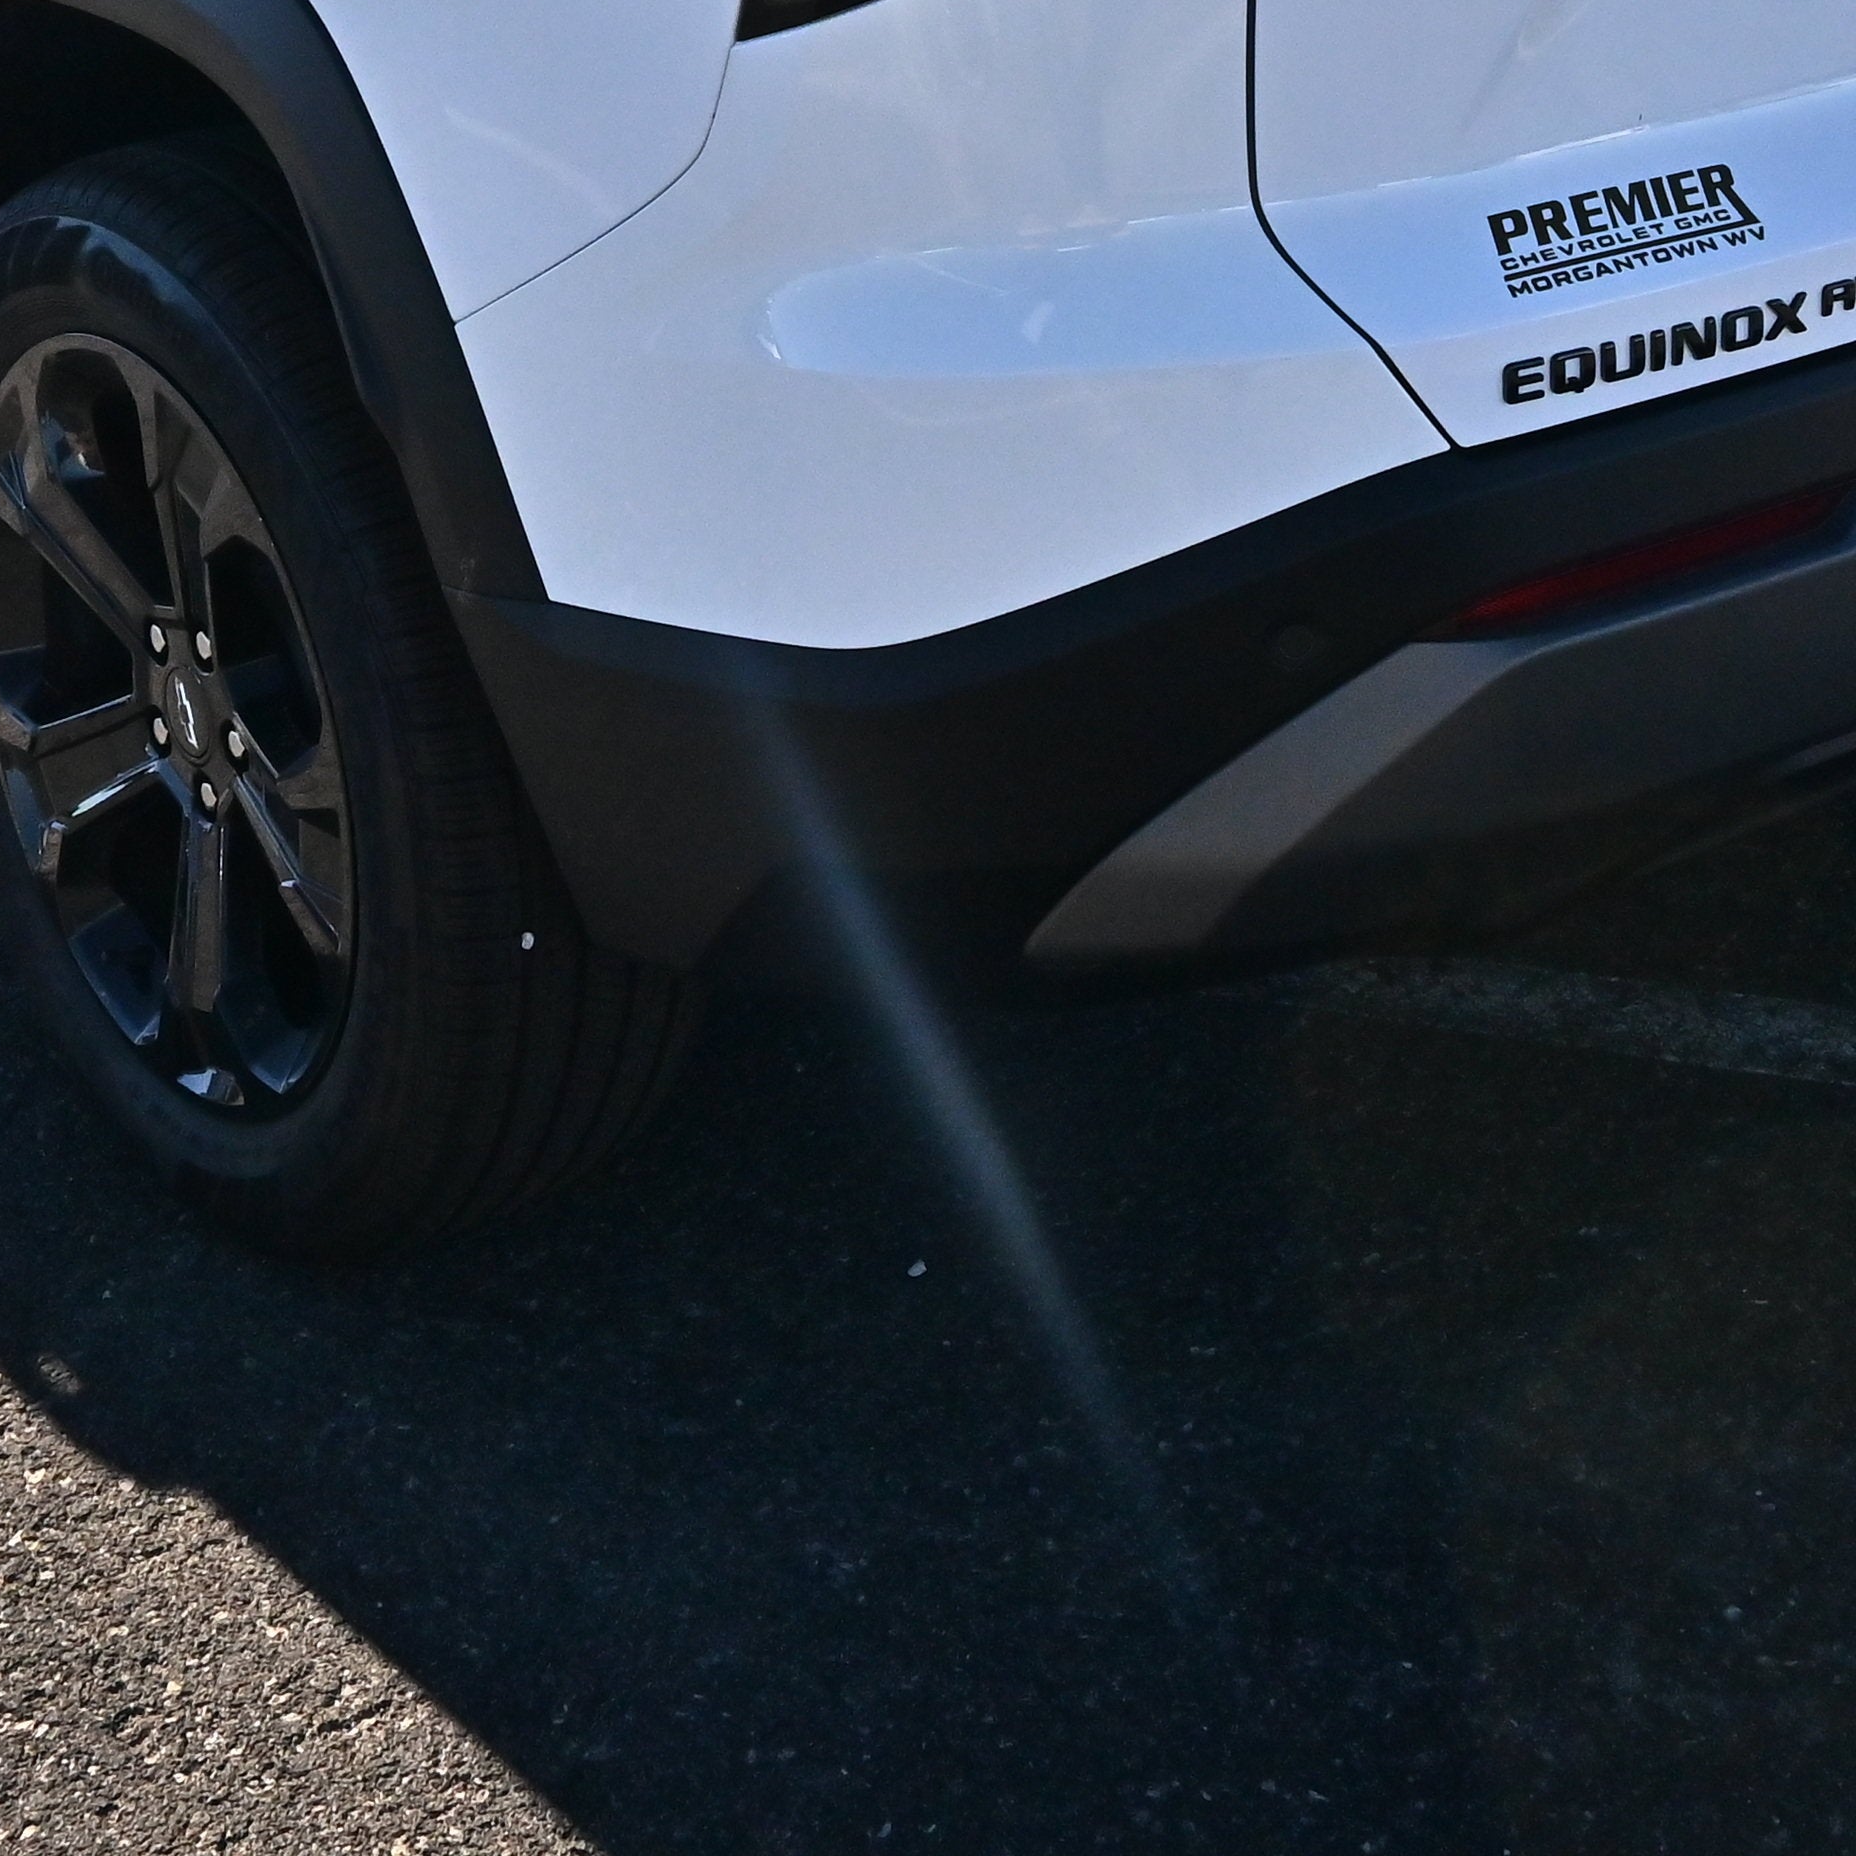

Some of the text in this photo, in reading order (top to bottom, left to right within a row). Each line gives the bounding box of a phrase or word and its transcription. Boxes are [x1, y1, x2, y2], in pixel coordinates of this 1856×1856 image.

[1487, 163, 1748, 257] PREMIER
[1499, 208, 1732, 273] CHEVROLET GMC
[1506, 226, 1766, 299] MORGANTOWN WV
[1501, 291, 1809, 407] EQUINOX
